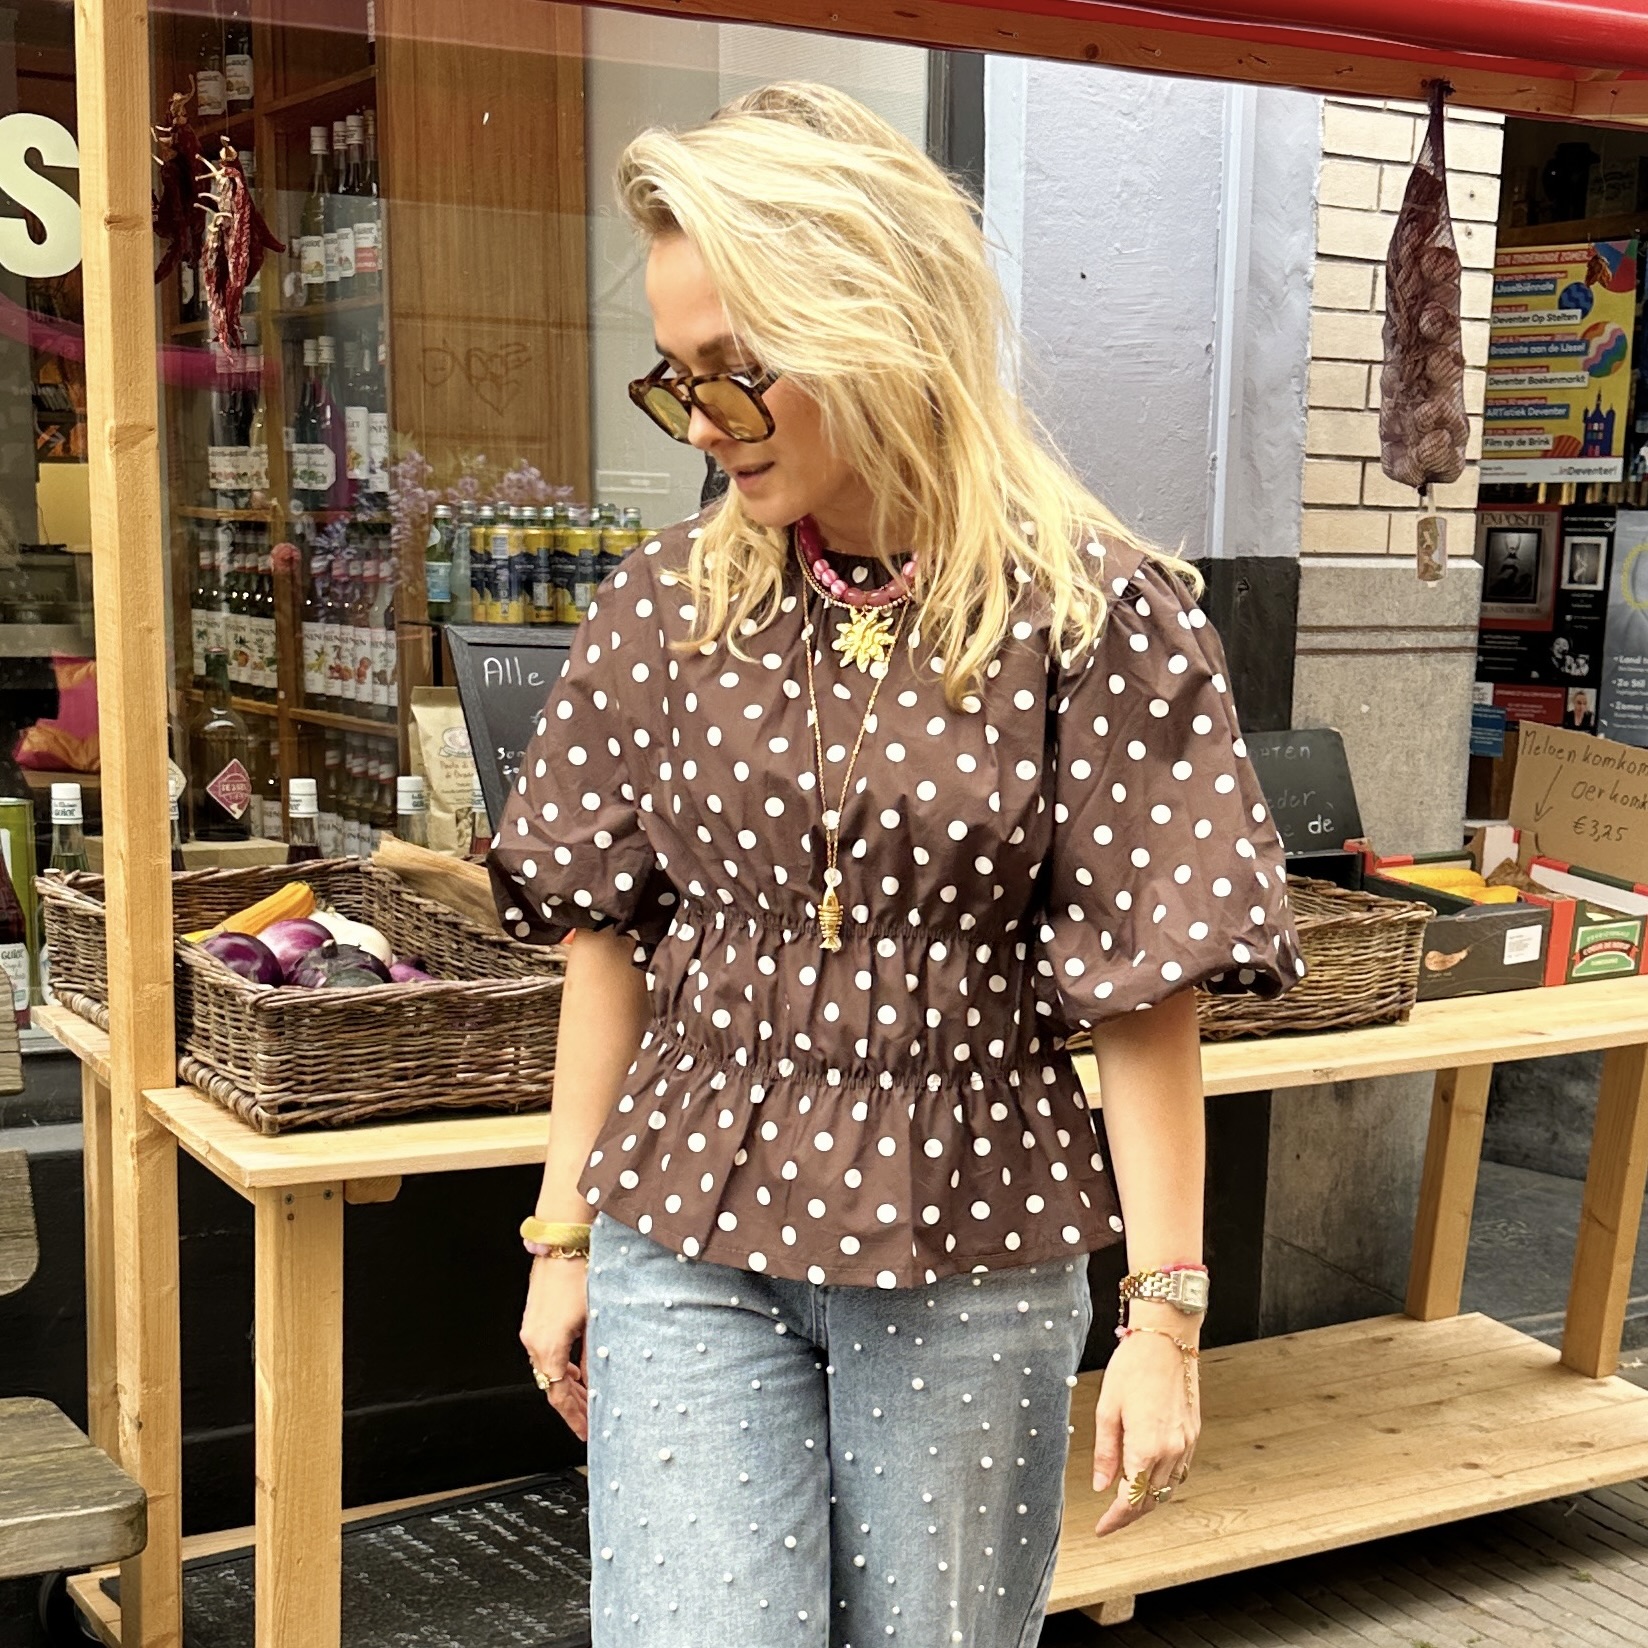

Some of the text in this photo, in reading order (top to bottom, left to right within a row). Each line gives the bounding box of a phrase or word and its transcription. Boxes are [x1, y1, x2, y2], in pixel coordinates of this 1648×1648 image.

[0, 112, 81, 279] S
[1492, 316, 1530, 324] Deventer
[1531, 314, 1545, 324] Op
[1488, 375, 1586, 385] Deventer Boekenmarkt
[1527, 406, 1567, 416] Deventer
[1484, 436, 1550, 448] Film op de Brink
[483, 656, 545, 688] Alle
[1307, 813, 1335, 835] de
[1573, 815, 1629, 842] €3,25
